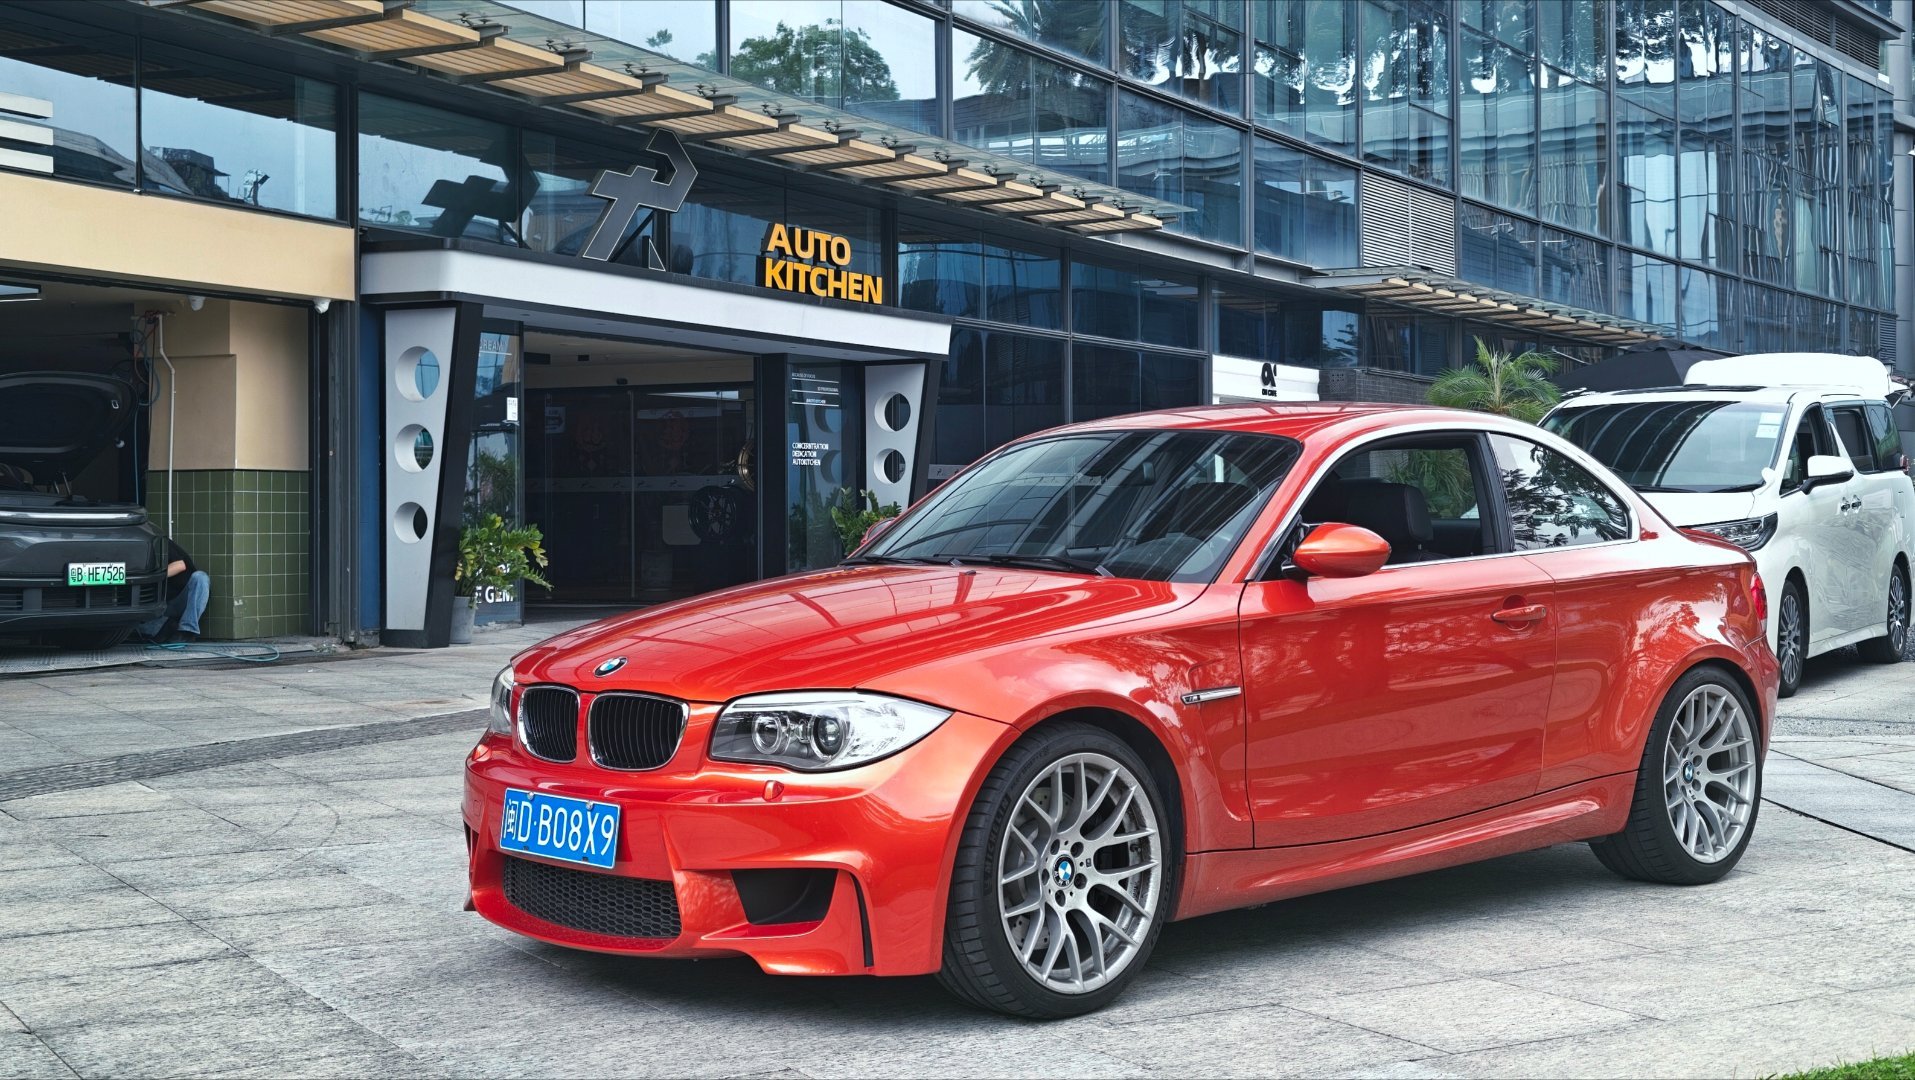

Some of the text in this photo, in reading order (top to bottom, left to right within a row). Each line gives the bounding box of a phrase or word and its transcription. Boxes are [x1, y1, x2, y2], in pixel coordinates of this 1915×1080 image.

[767, 223, 851, 266] AUTO
[765, 257, 883, 304] KITCHEN
[792, 442, 829, 450] CONCENTRATION
[792, 450, 817, 458] DEDICATION
[88, 566, 125, 582] HE7526
